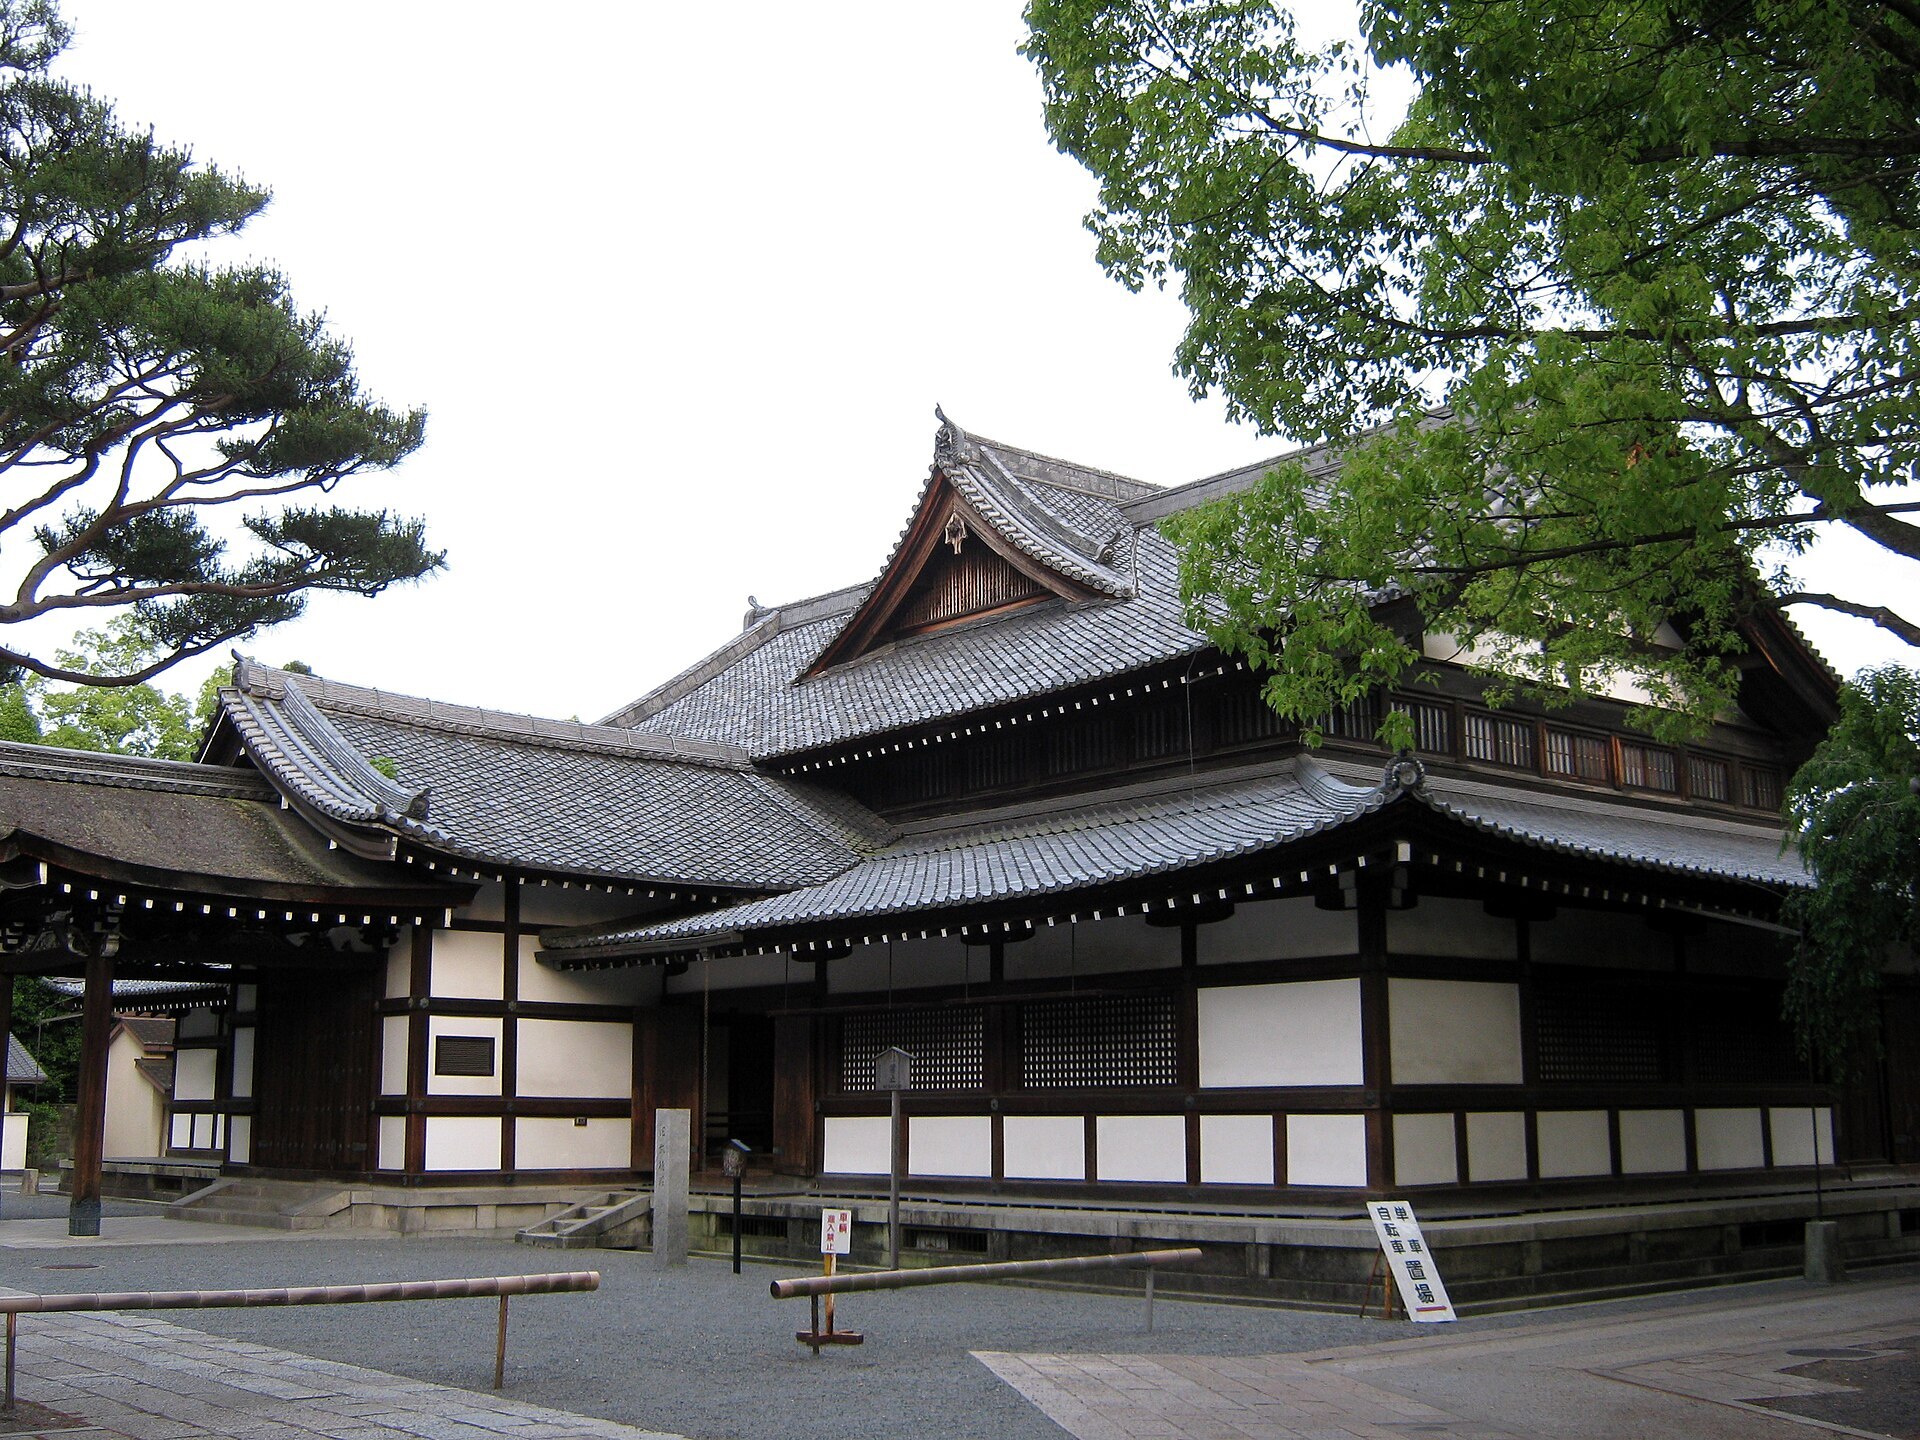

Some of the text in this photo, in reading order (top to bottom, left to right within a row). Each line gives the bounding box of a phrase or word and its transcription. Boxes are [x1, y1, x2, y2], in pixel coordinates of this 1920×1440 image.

[1377, 1206, 1406, 1254] 自転車
[1405, 1260, 1435, 1304] 置場
